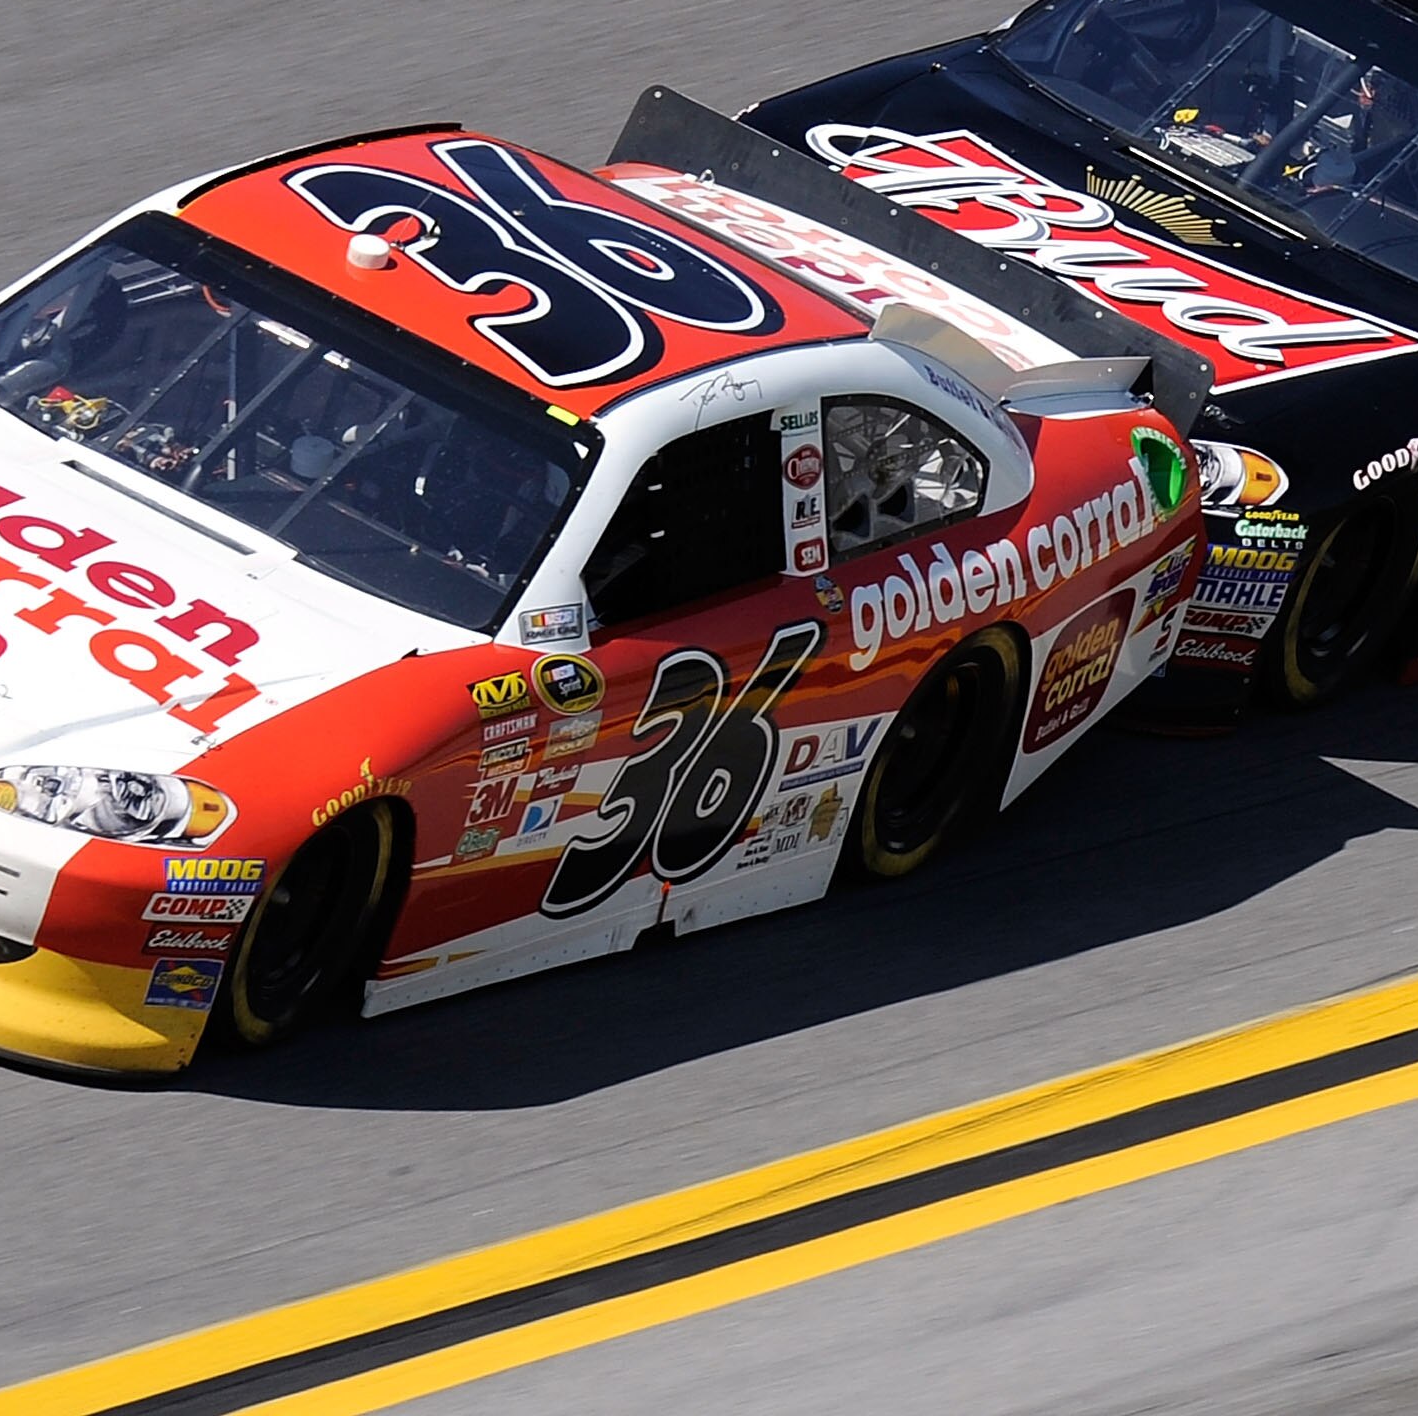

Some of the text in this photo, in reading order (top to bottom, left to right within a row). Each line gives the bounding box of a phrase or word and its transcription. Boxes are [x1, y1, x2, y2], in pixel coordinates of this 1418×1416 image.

[805, 124, 1393, 362] Bud
[283, 139, 784, 390] 36
[781, 410, 818, 431] SELLARS
[1235, 518, 1309, 540] Gatorback
[848, 542, 1028, 673] golden
[1026, 456, 1169, 591] corral
[1208, 543, 1299, 572] MOOG
[1197, 576, 1285, 608] MAHLE
[1044, 615, 1120, 679] golden
[1175, 638, 1257, 666] Edelbrock
[1044, 640, 1119, 712] corral
[484, 714, 537, 741] CRAFTSMAN
[784, 716, 882, 775] DAV
[540, 616, 824, 920] 36
[469, 784, 519, 822] 3M
[168, 859, 263, 880] MOOG
[152, 897, 226, 917] COMP
[148, 930, 231, 951] Edelbrock
[157, 971, 216, 986] SUNOCO
